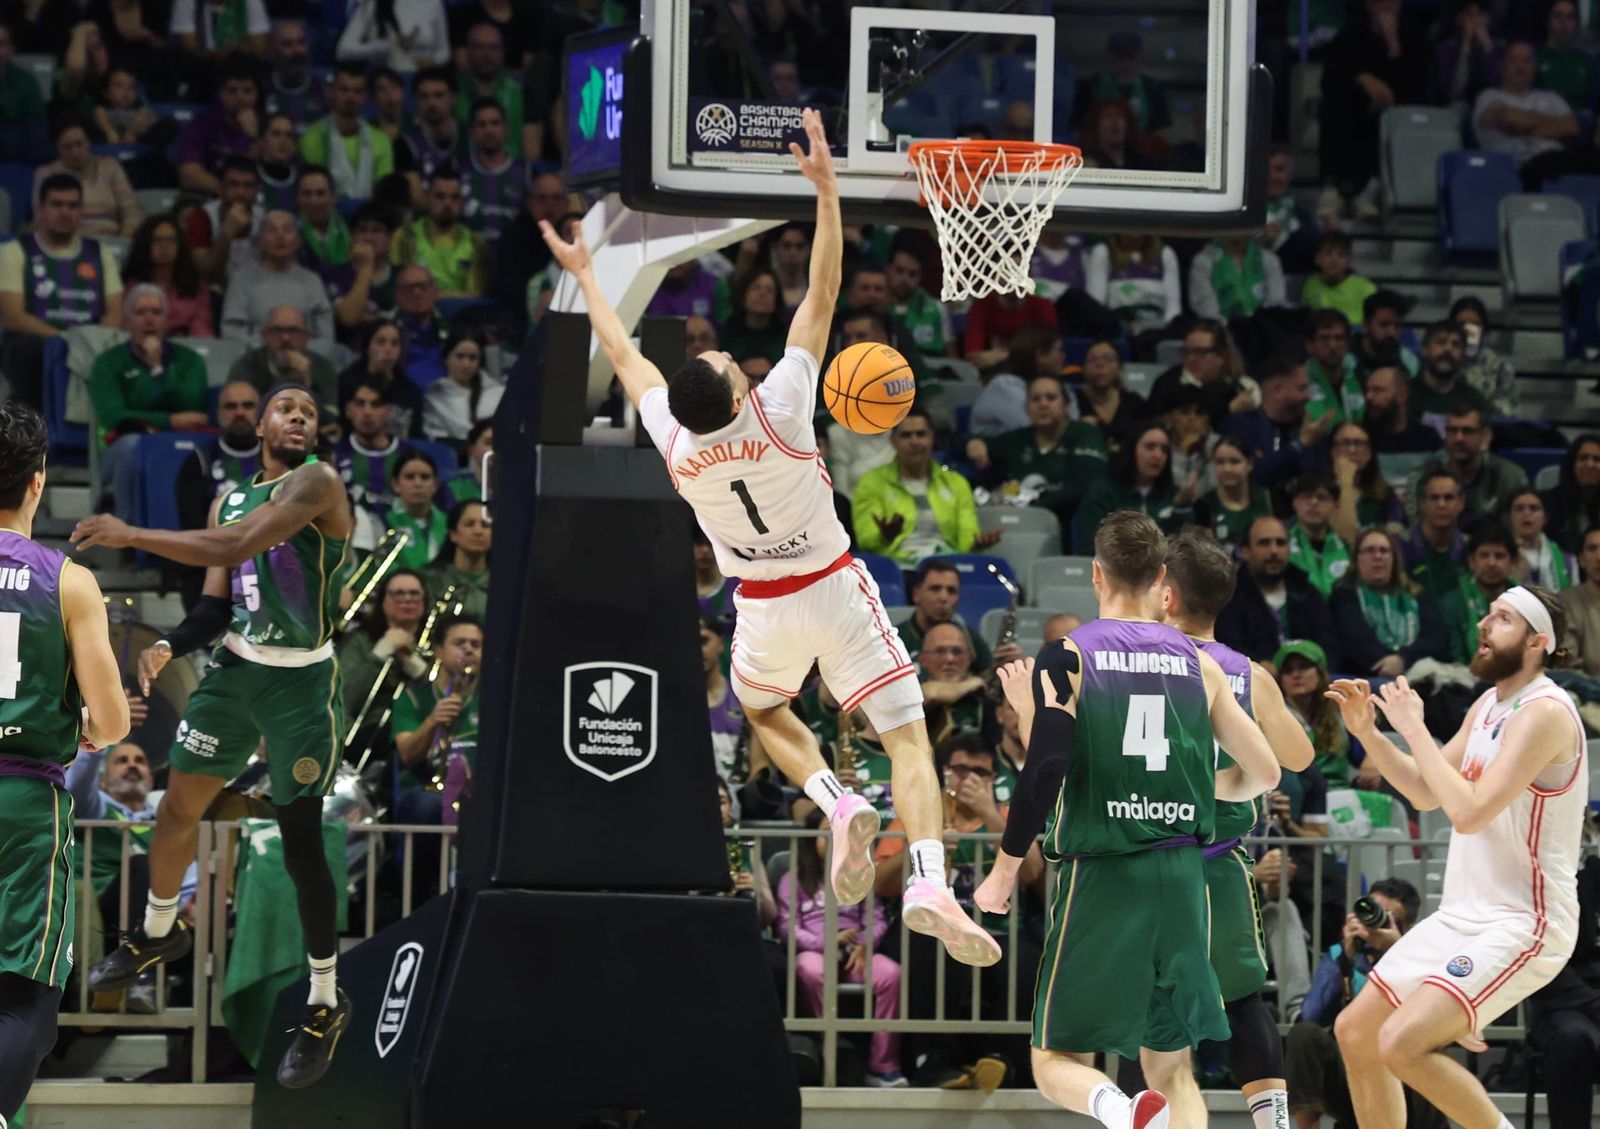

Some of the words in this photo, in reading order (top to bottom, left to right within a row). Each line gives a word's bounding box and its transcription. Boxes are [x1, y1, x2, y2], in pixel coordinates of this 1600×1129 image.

[739, 105, 803, 117] BASKETBAL
[739, 115, 805, 129] CHAMPIO
[739, 127, 784, 138] LEAGUE
[739, 139, 776, 149] SEASON
[776, 141, 783, 149] X
[676, 439, 770, 481] NADOLNY
[730, 479, 770, 535] 1
[762, 531, 808, 555] VICKY
[1094, 650, 1190, 677] KALINOSKI
[579, 717, 643, 732] Fundación
[1121, 694, 1171, 772] 4
[189, 728, 219, 746] COSTA
[587, 731, 634, 748] Unicaja
[578, 743, 643, 757] Baloncesto
